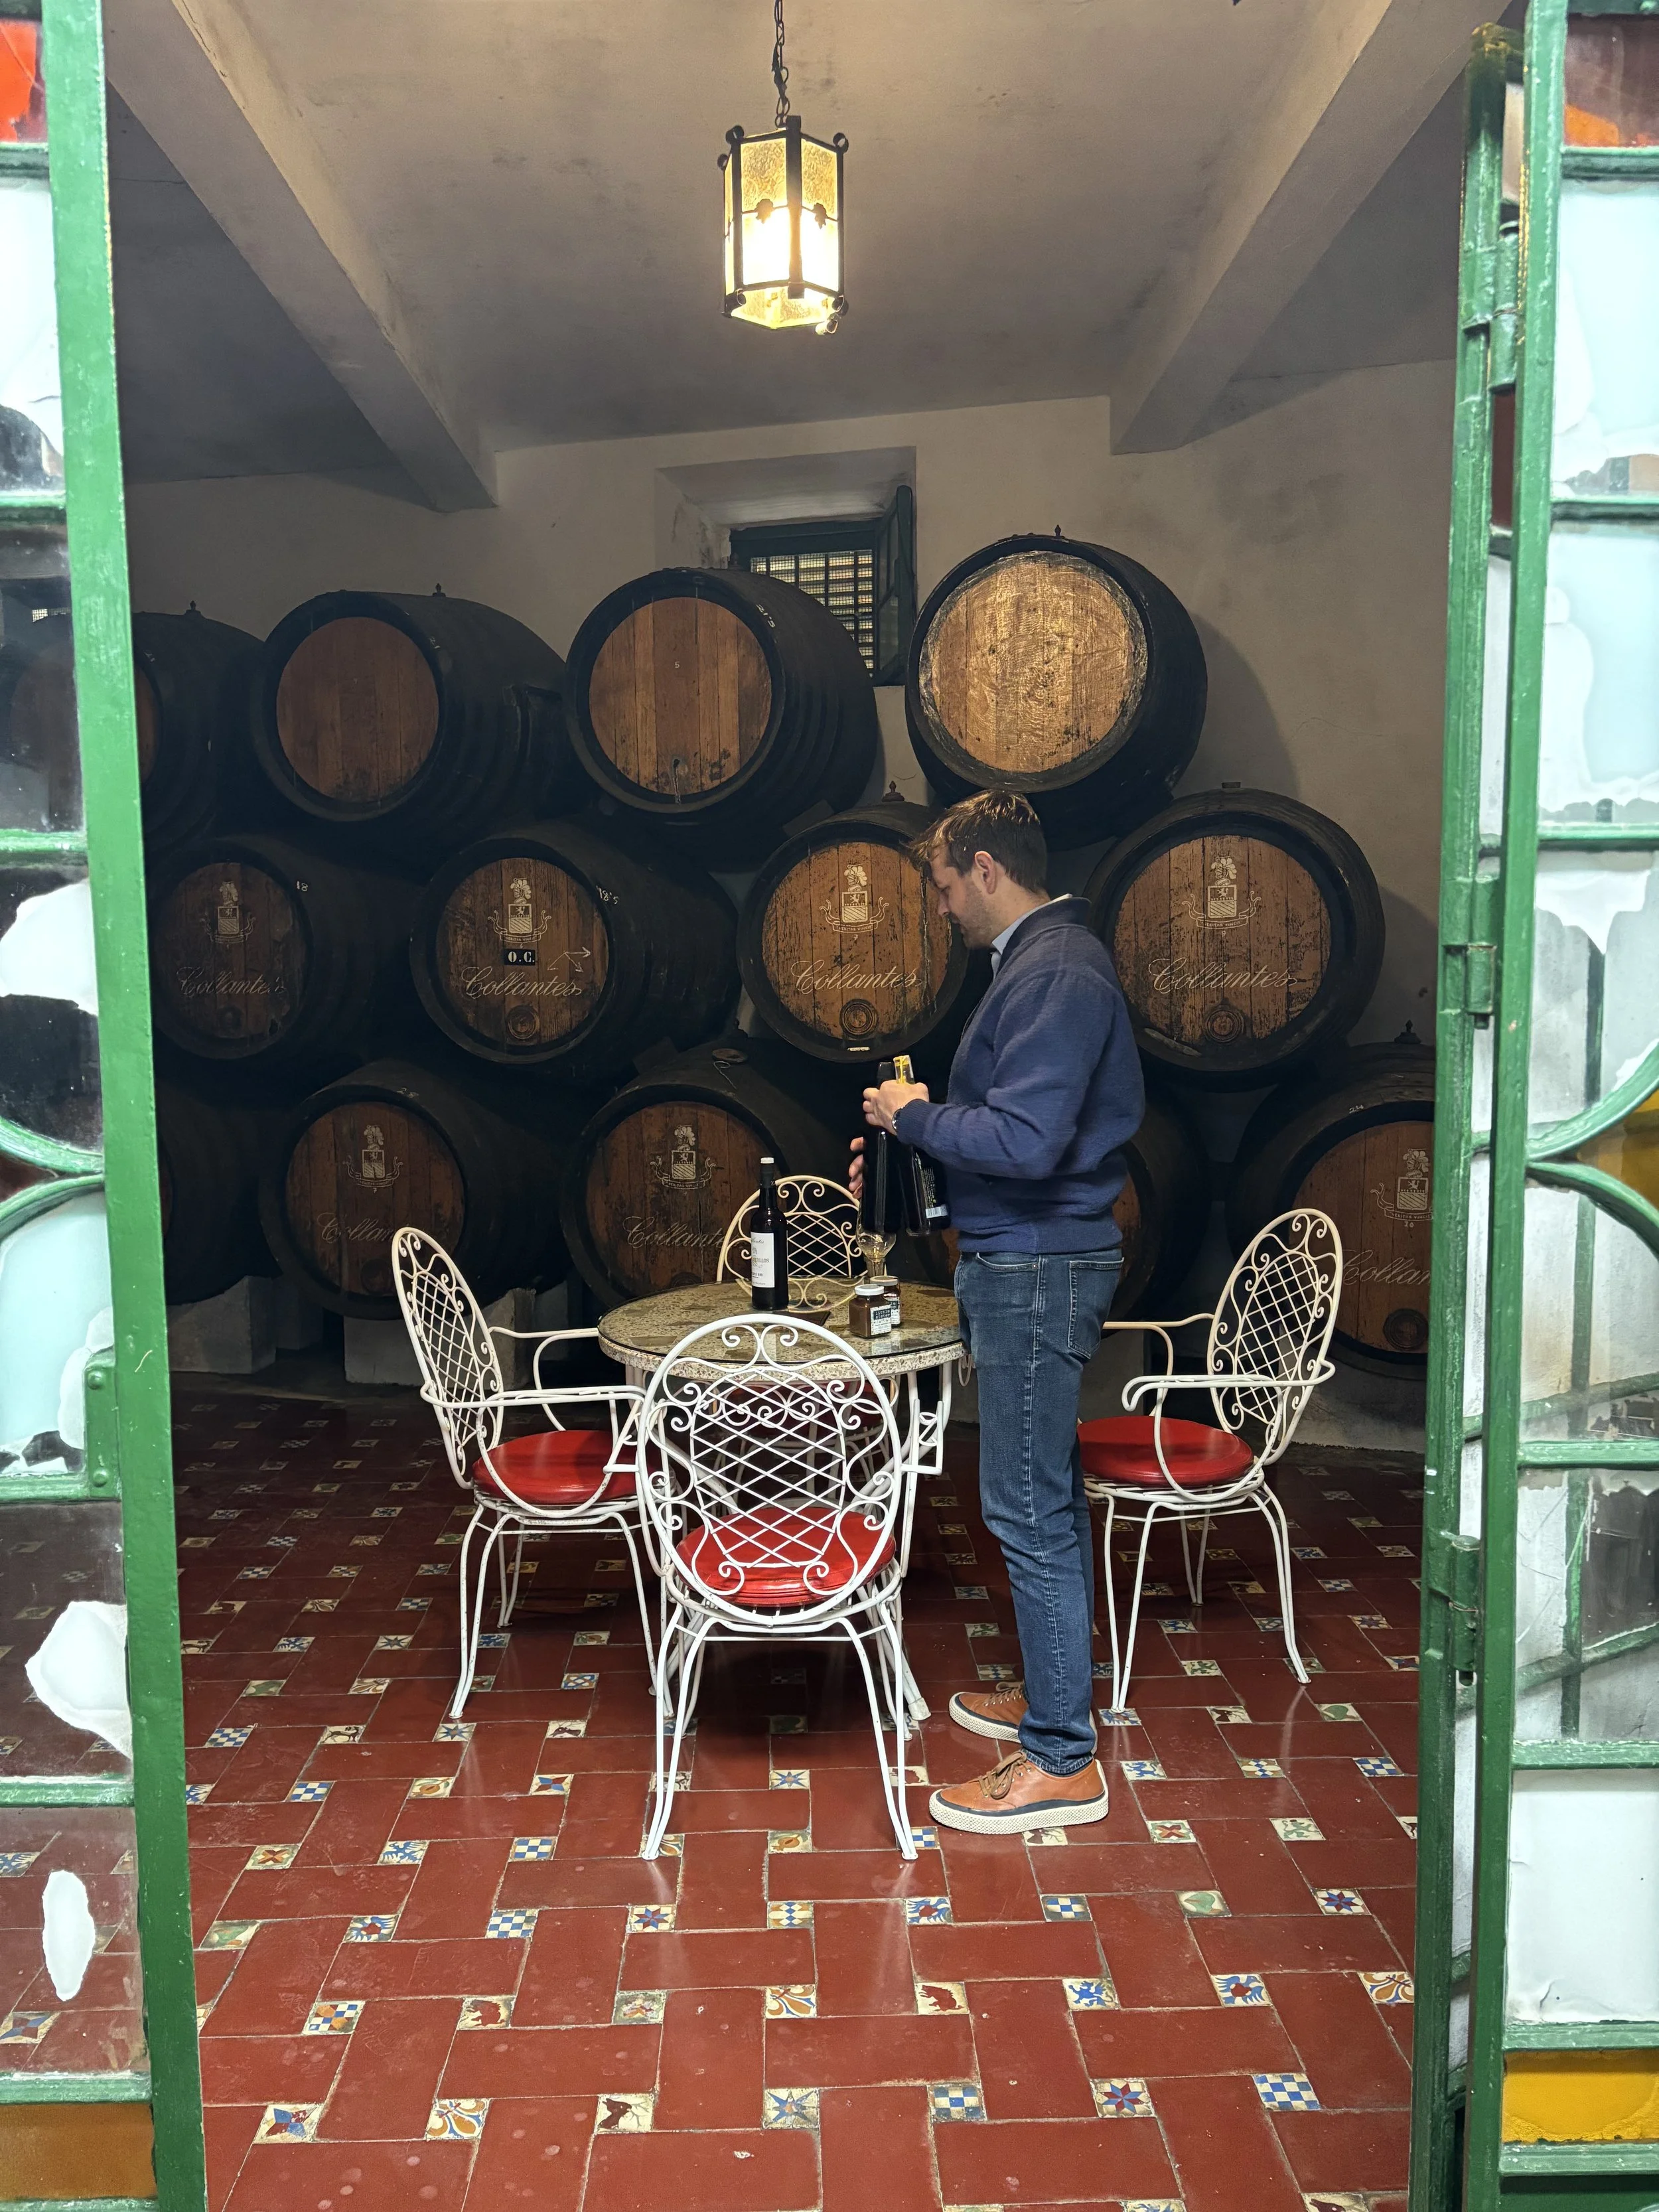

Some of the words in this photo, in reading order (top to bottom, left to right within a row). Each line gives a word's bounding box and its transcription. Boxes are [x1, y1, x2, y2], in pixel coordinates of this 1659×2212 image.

[508, 951, 535, 963] O.C.
[461, 966, 582, 999] Collantes
[790, 959, 923, 995] Collantes
[1148, 957, 1297, 994] Collantes
